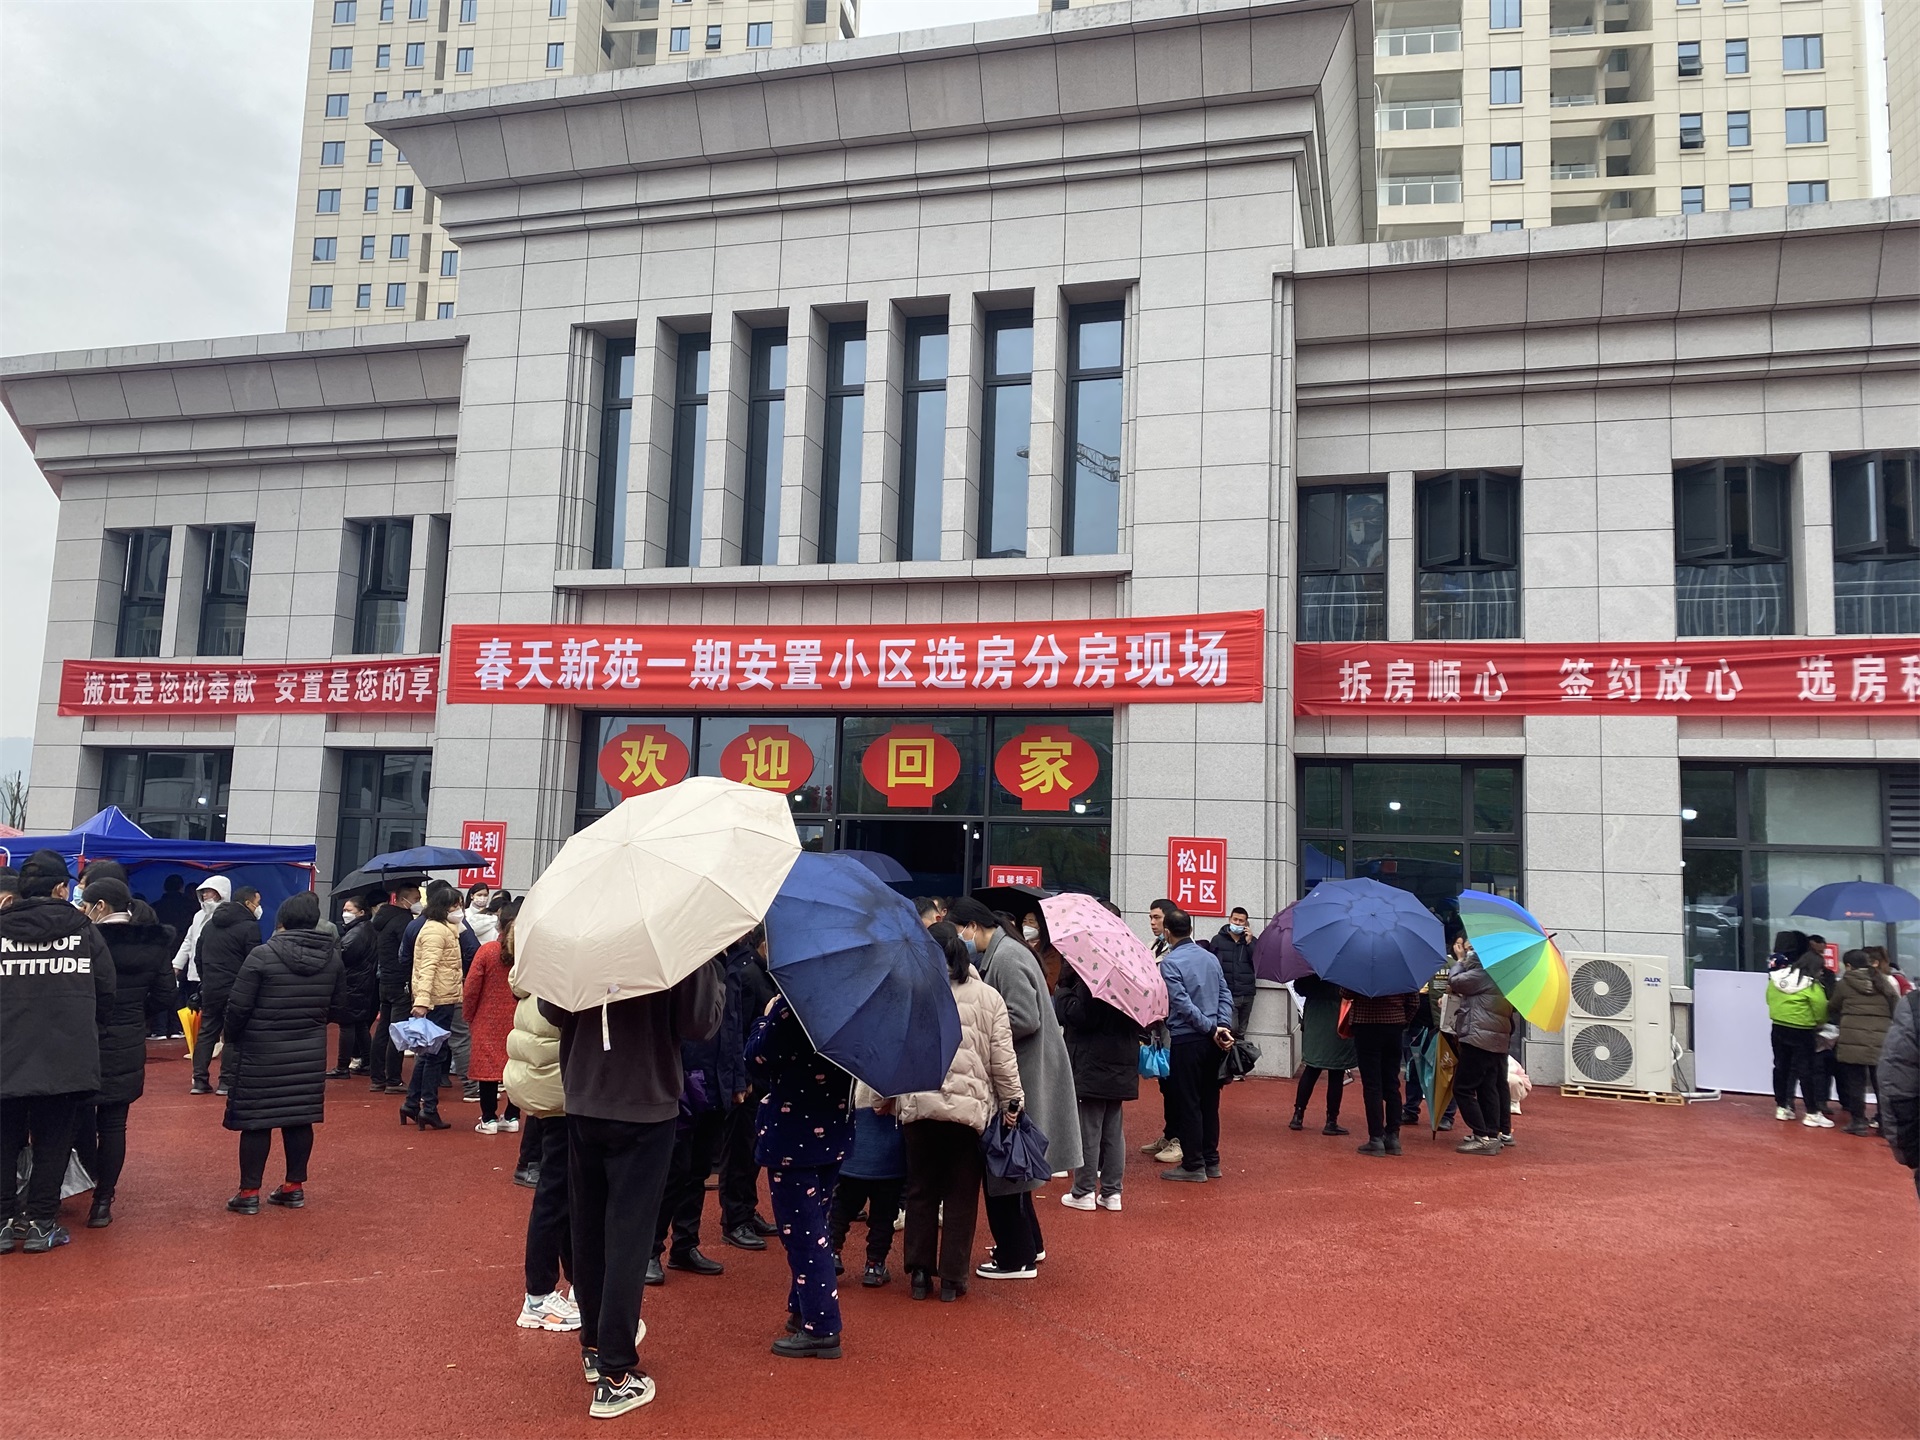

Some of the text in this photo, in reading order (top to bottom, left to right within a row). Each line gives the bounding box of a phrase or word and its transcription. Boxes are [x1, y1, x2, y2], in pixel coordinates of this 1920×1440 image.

[474, 628, 1228, 691] 春天新苑一期安置小区选房分房现场
[82, 665, 434, 706] 搬迁是您的奉献 安置是您的享
[1339, 658, 1509, 704] 拆房顺心
[1559, 657, 1744, 704] 签约放心
[467, 831, 500, 853] 胜利
[1177, 848, 1217, 874] 松山
[1177, 877, 1217, 904] 片区
